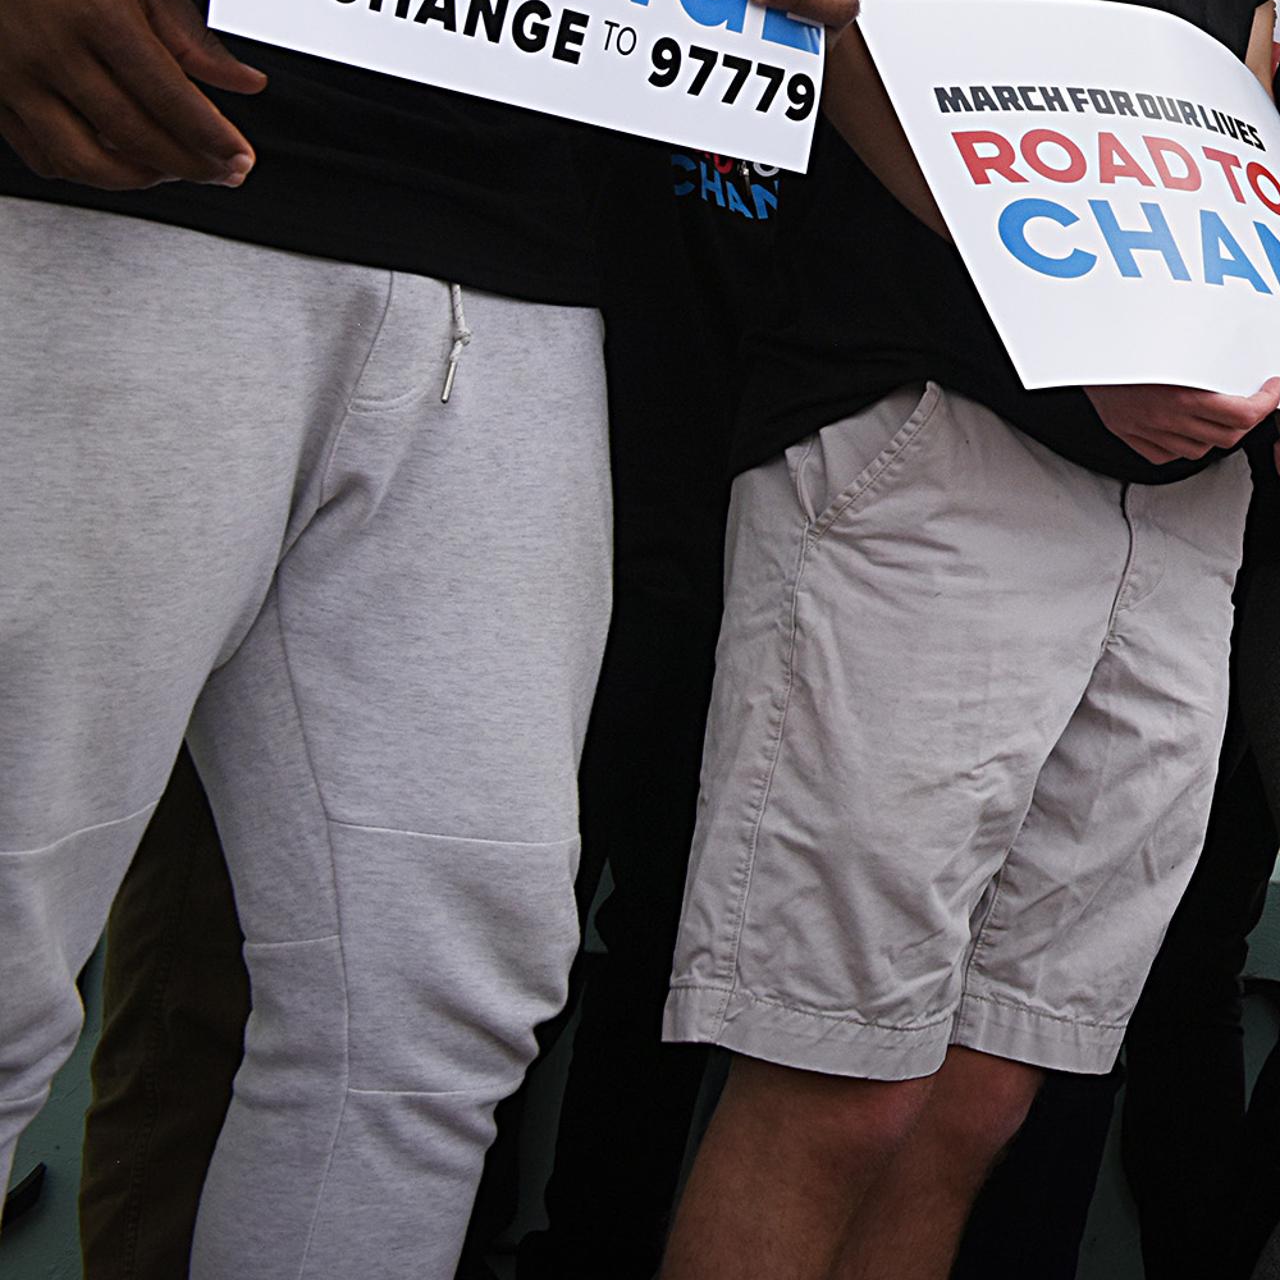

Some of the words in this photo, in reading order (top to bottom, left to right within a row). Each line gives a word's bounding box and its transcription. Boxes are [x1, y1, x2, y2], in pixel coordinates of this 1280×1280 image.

[603, 20, 637, 57] TO
[648, 37, 816, 122] 97779
[934, 86, 1068, 113] MARCH
[1071, 87, 1138, 117] FOR
[1136, 92, 1201, 128] OUR
[1199, 103, 1267, 152] LIVES
[671, 153, 778, 220] CHAN
[950, 128, 1202, 193] ROAD
